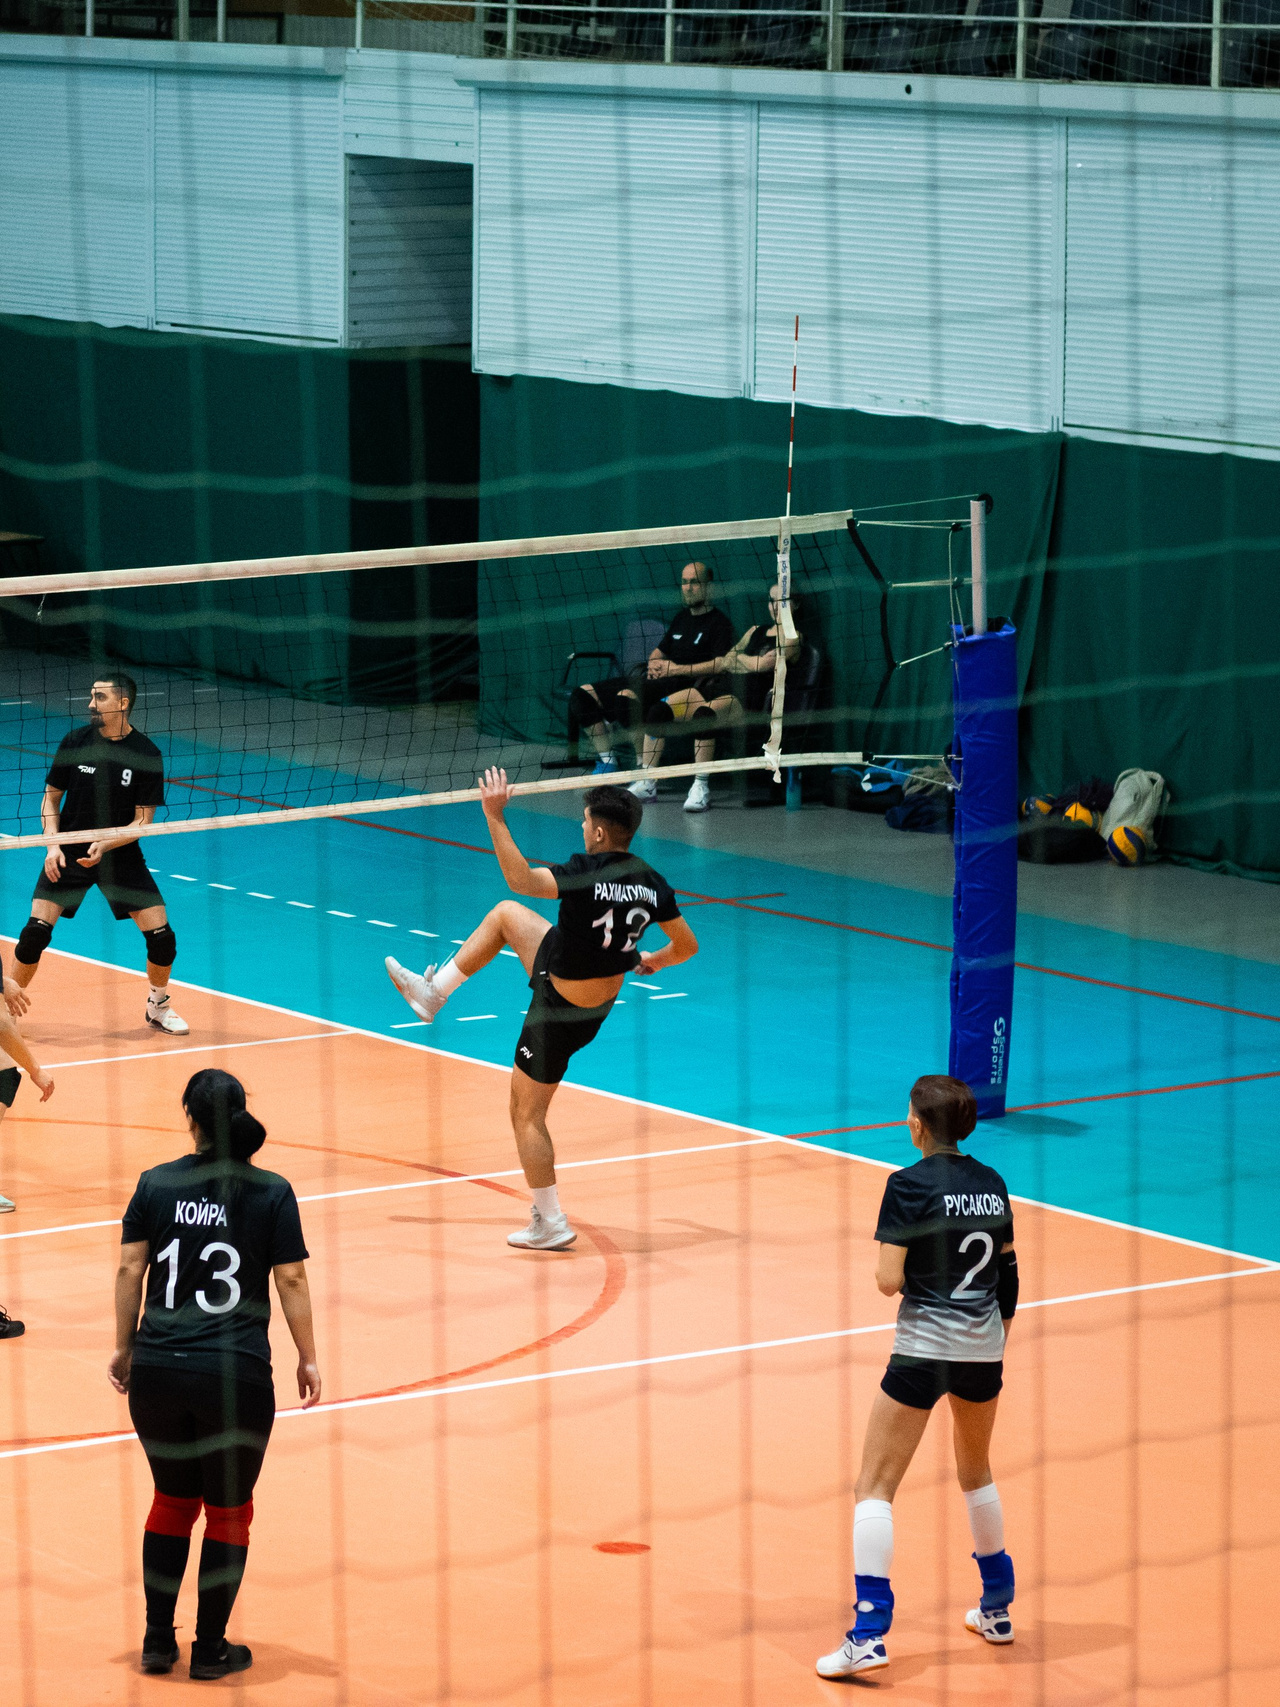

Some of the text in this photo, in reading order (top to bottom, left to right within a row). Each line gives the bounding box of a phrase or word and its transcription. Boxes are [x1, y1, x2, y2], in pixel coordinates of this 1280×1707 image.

[121, 769, 132, 787] 9
[592, 908, 651, 953] 12
[175, 1197, 228, 1227] КОЙРА
[943, 1193, 1005, 1217] РУСАКОВА
[157, 1238, 241, 1314] 13
[950, 1231, 994, 1299] 2
